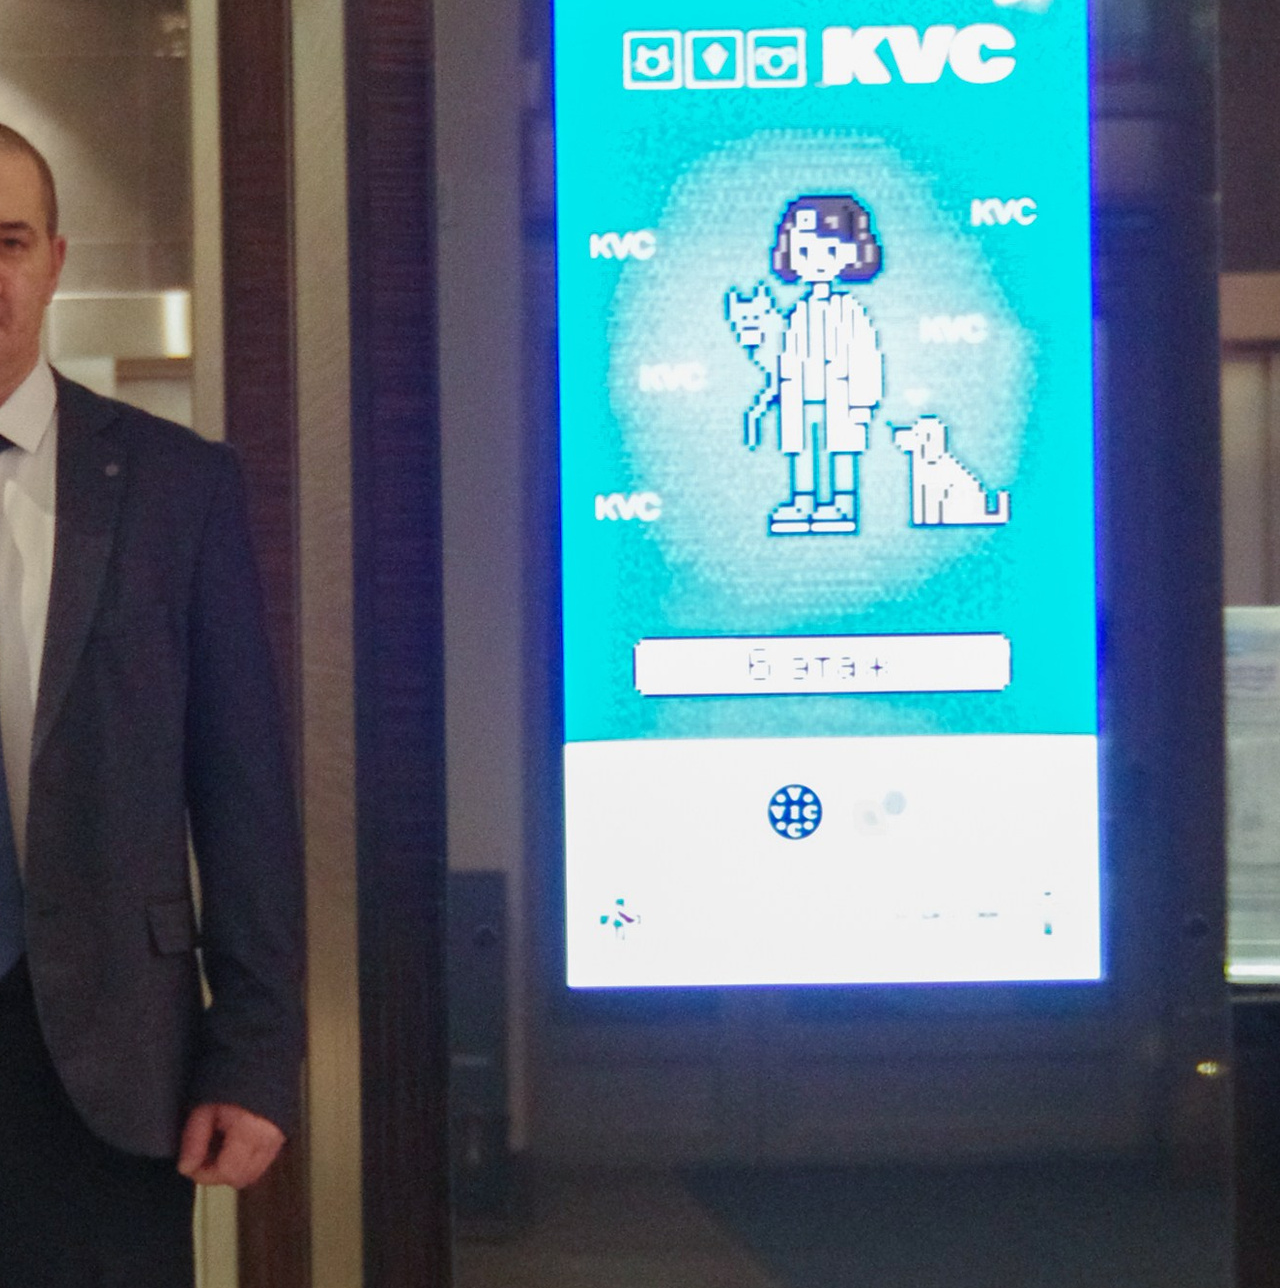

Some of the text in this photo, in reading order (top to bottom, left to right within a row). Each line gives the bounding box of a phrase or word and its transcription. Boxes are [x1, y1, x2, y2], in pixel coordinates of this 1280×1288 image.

[822, 24, 1016, 84] KVC
[971, 198, 1036, 225] KVC
[590, 232, 655, 258] KVC
[595, 494, 660, 521] KVC
